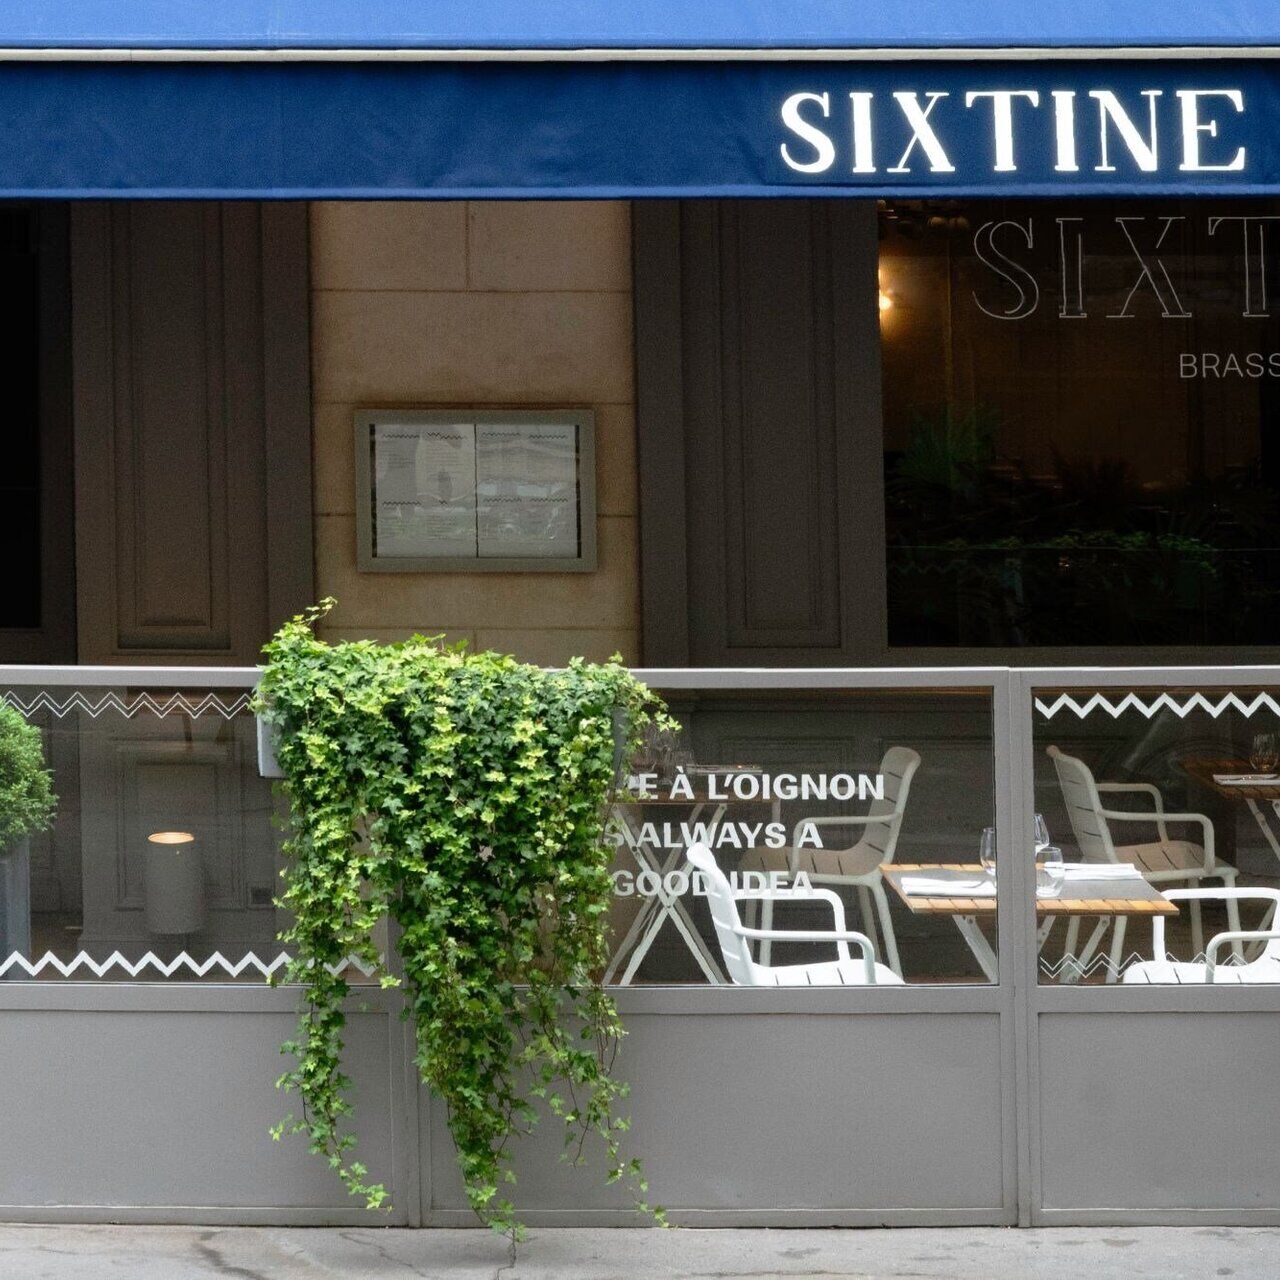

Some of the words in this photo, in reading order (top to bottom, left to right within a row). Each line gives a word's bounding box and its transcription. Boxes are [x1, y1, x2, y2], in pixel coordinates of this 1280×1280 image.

[780, 89, 1246, 173] SIXTINE
[669, 765, 695, 800] À
[636, 822, 787, 849] ALWAYS
[797, 822, 824, 849] A
[612, 869, 716, 897] GOOD
[729, 870, 814, 897] IDEA
